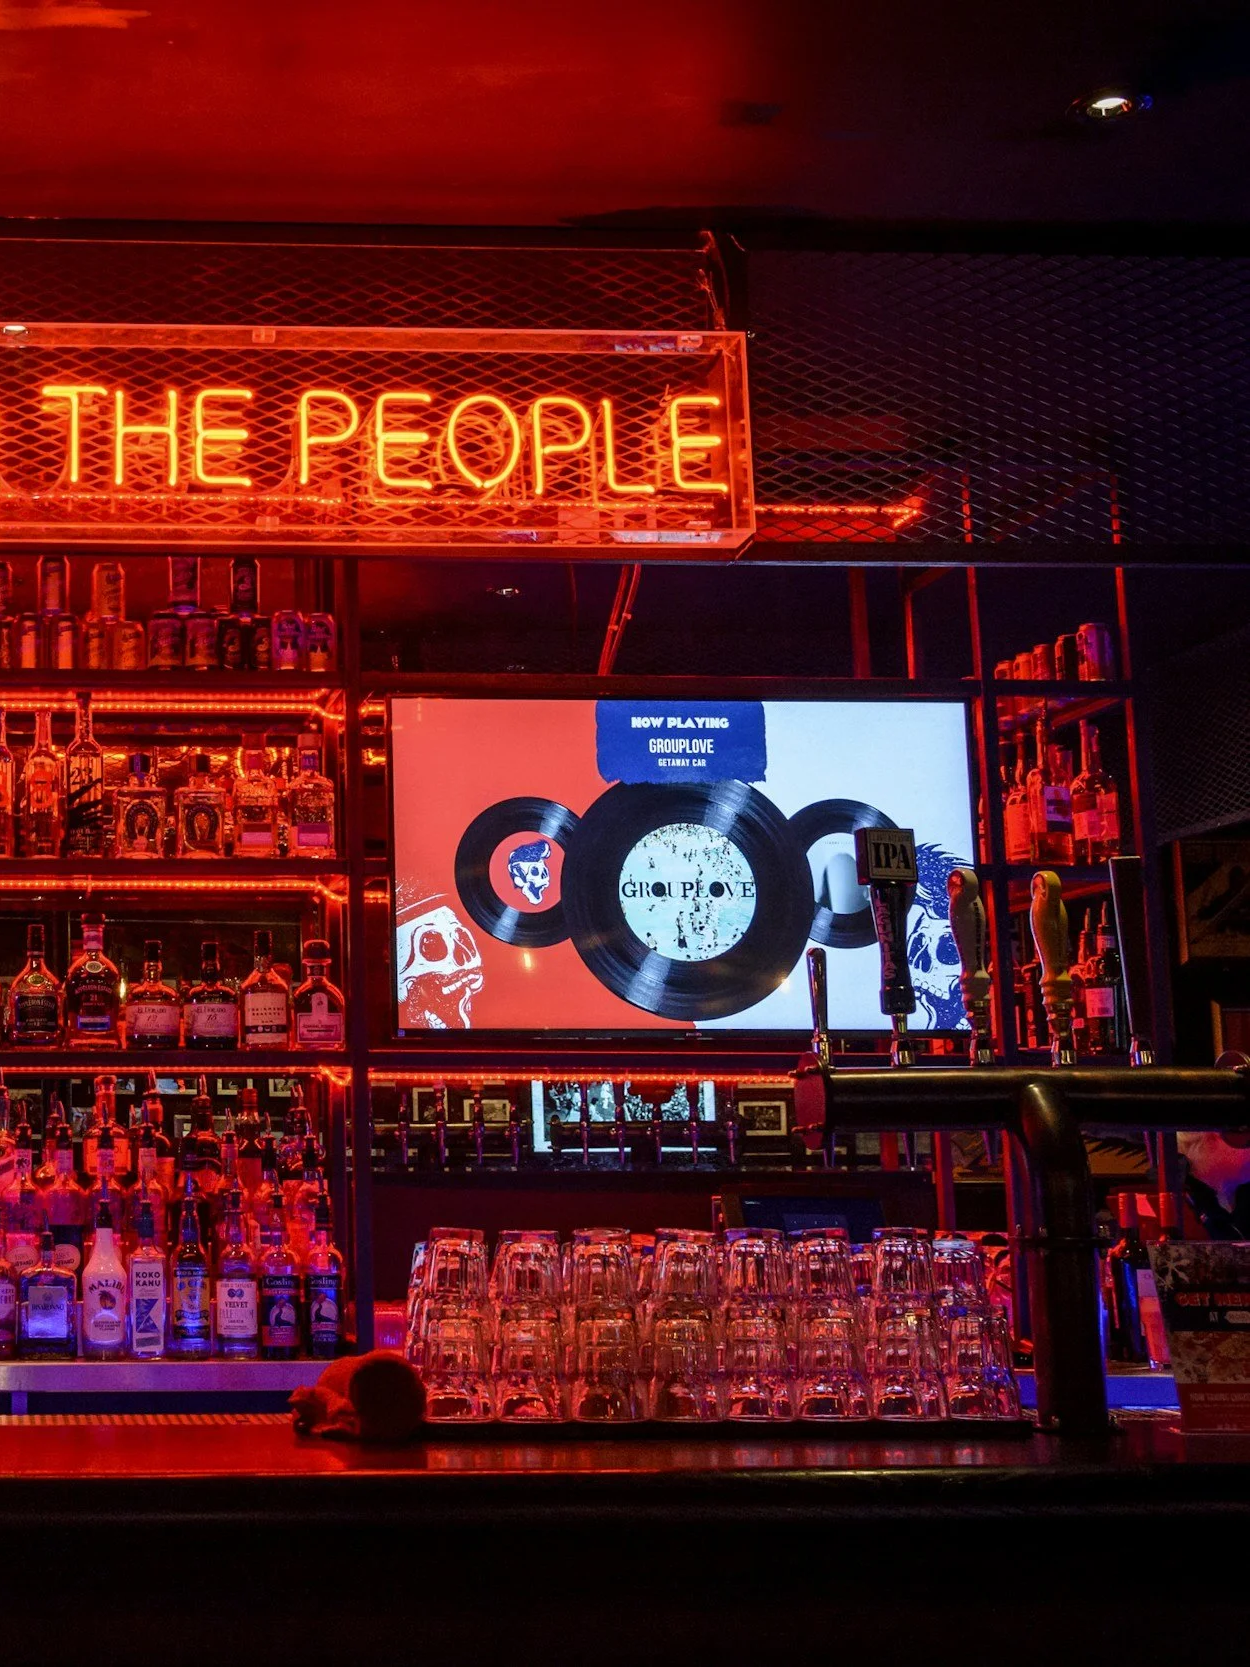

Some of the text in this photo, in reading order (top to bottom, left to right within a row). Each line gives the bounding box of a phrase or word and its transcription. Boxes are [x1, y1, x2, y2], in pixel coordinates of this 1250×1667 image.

[41, 384, 253, 487] THE
[297, 387, 729, 495] PEOPLE
[631, 717, 730, 729] NOW PLAYING
[649, 739, 715, 754] GROUPLOVE
[658, 758, 707, 767] GETAWAY CAR
[872, 842, 911, 869] IPA
[622, 881, 755, 898] GROUPLOVE
[88, 1279, 125, 1294] MALIBU
